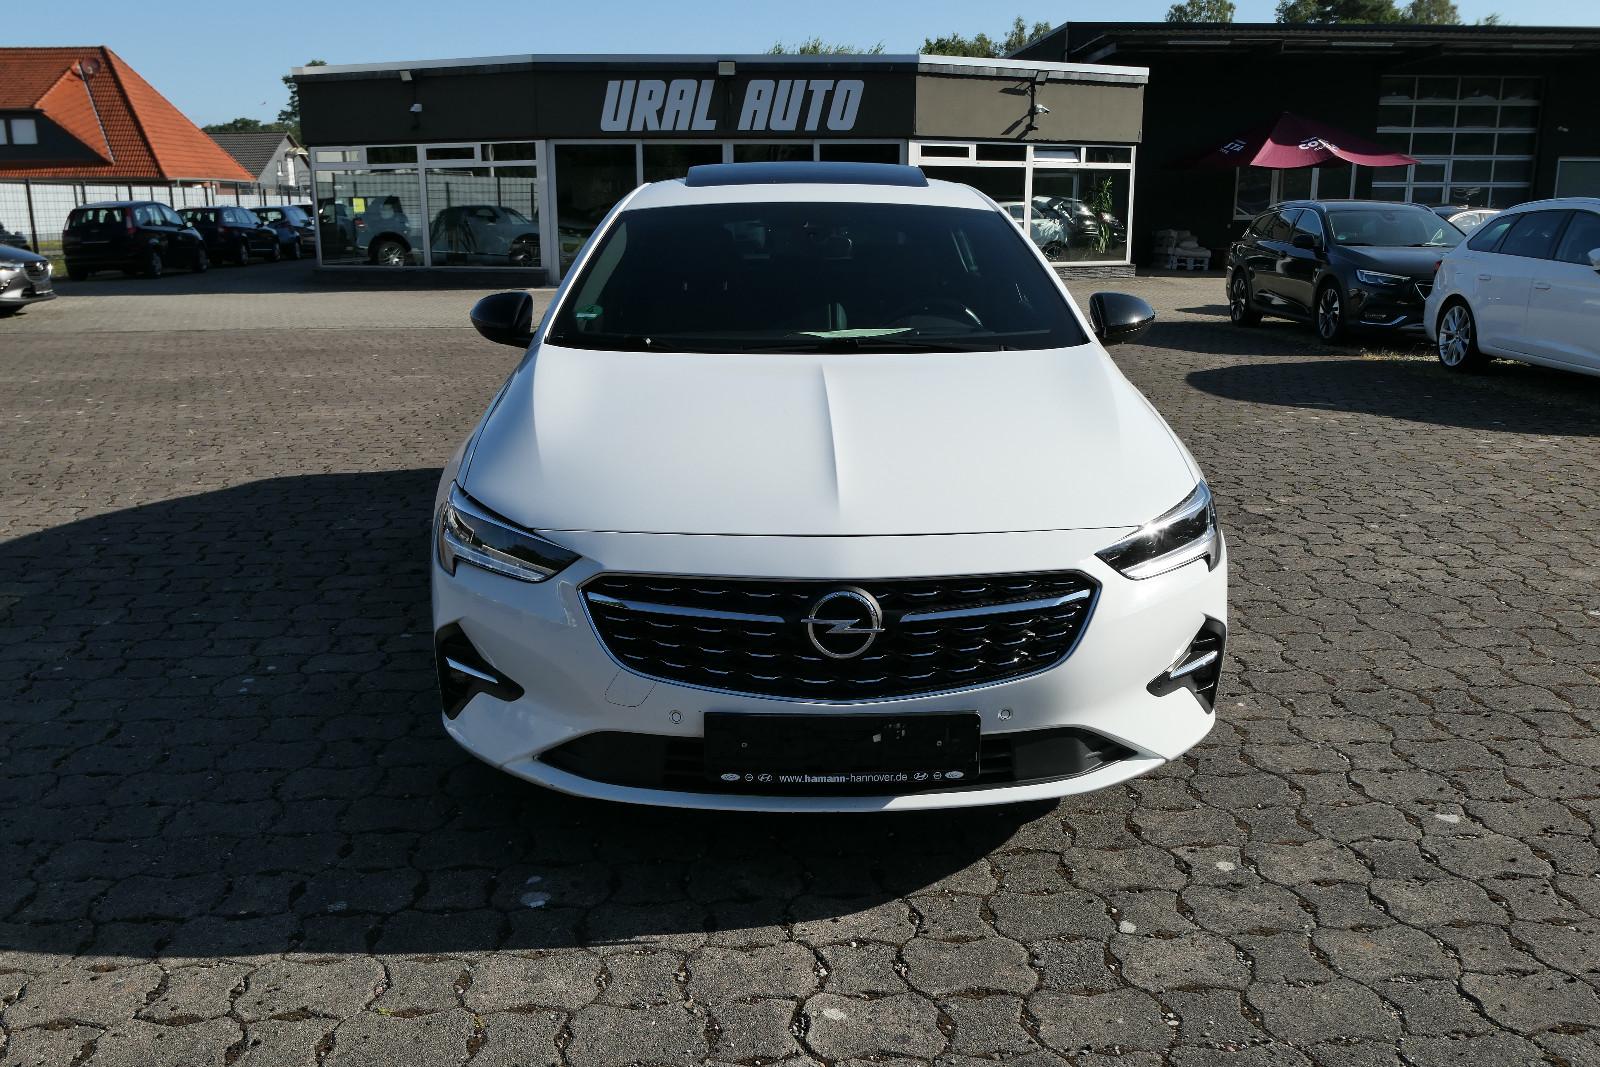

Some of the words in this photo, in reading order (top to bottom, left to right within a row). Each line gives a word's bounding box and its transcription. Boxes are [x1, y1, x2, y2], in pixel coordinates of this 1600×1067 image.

[600, 79, 717, 131] URAL
[737, 79, 865, 131] AUTO
[779, 772, 908, 783] www.hamann-hannover.de
